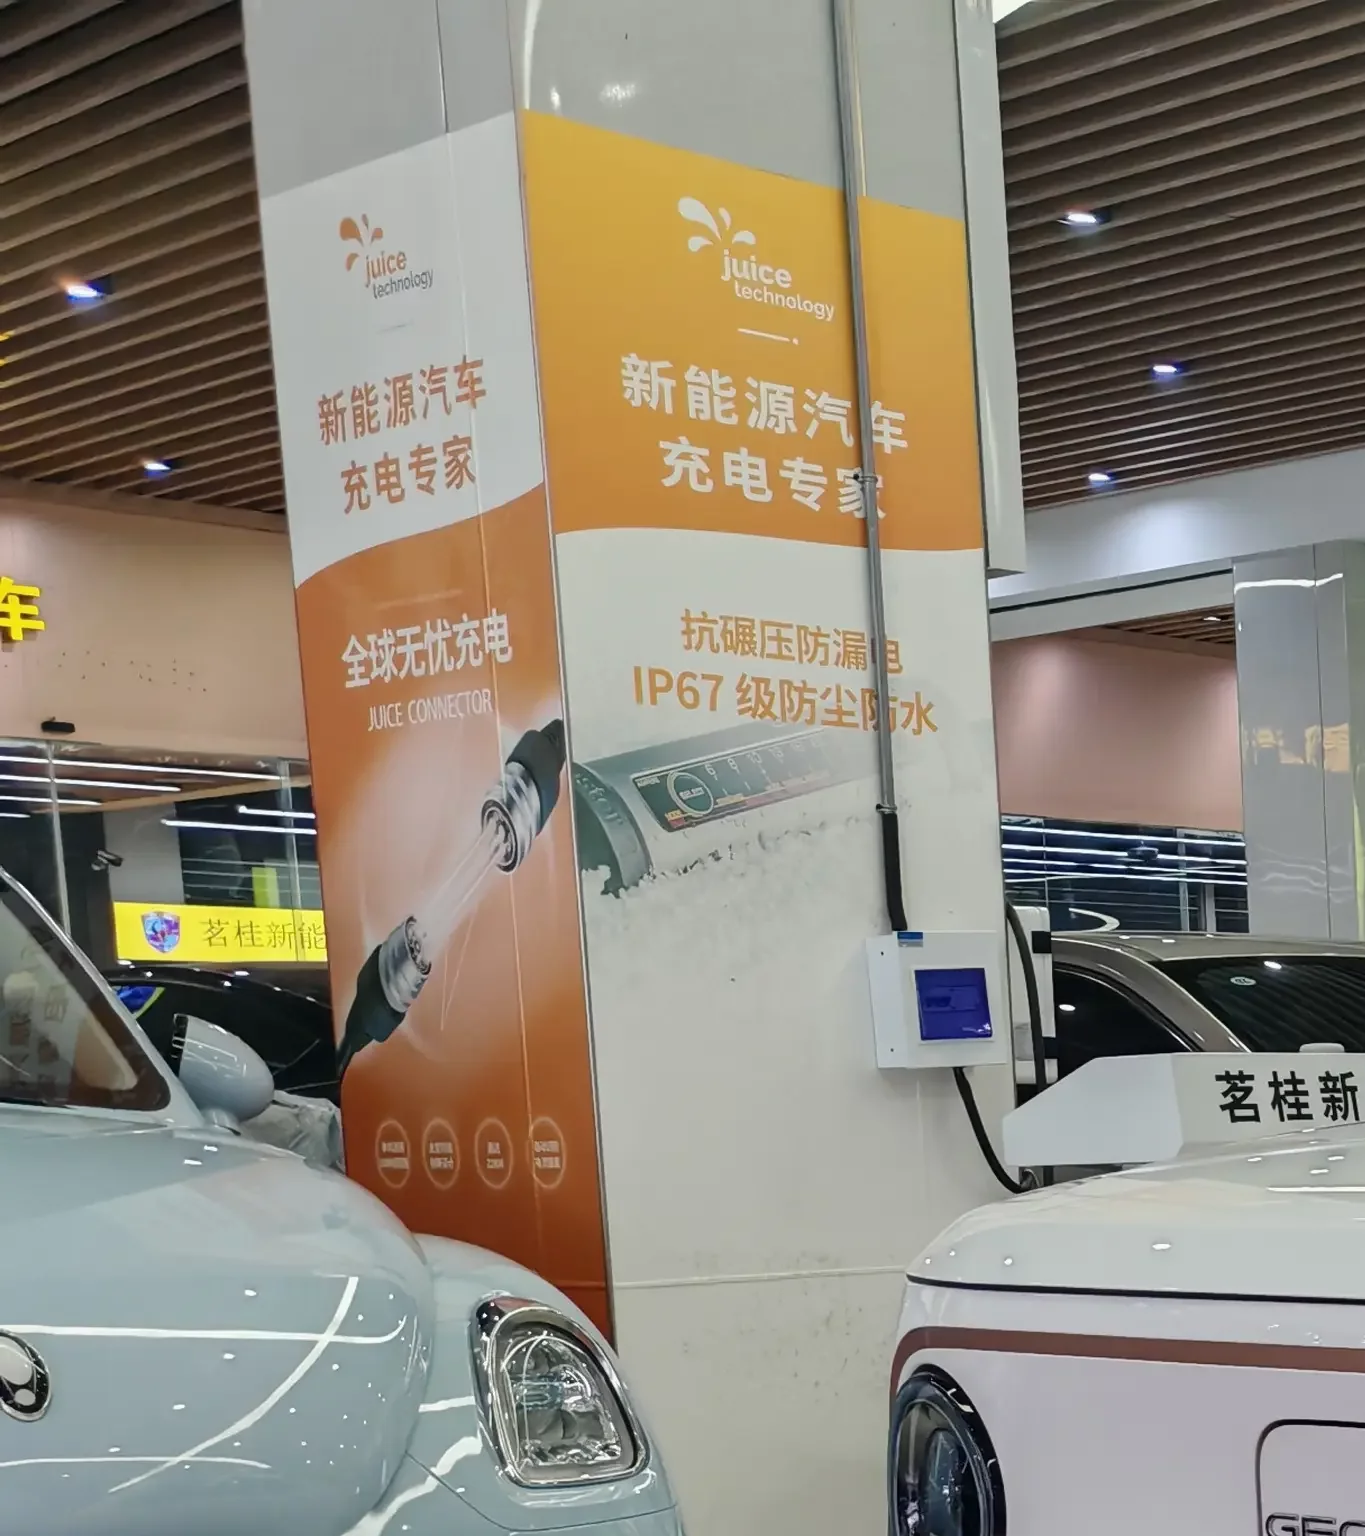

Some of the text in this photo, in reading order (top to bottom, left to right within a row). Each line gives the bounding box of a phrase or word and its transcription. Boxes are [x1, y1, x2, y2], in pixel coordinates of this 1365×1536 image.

[364, 250, 408, 288] juice
[372, 269, 434, 300] technology
[721, 249, 793, 289] juice
[734, 280, 834, 322] technology
[318, 354, 487, 446] 新能源汽车
[620, 352, 909, 455] 新能源汽车
[340, 434, 477, 515] 充电专家
[659, 436, 887, 520] 充电专家
[341, 607, 513, 689] 全球无忧充电
[367, 688, 494, 732] JUICE CONNECTOR
[633, 665, 725, 712] IP67
[200, 918, 327, 950] 茗桂新能
